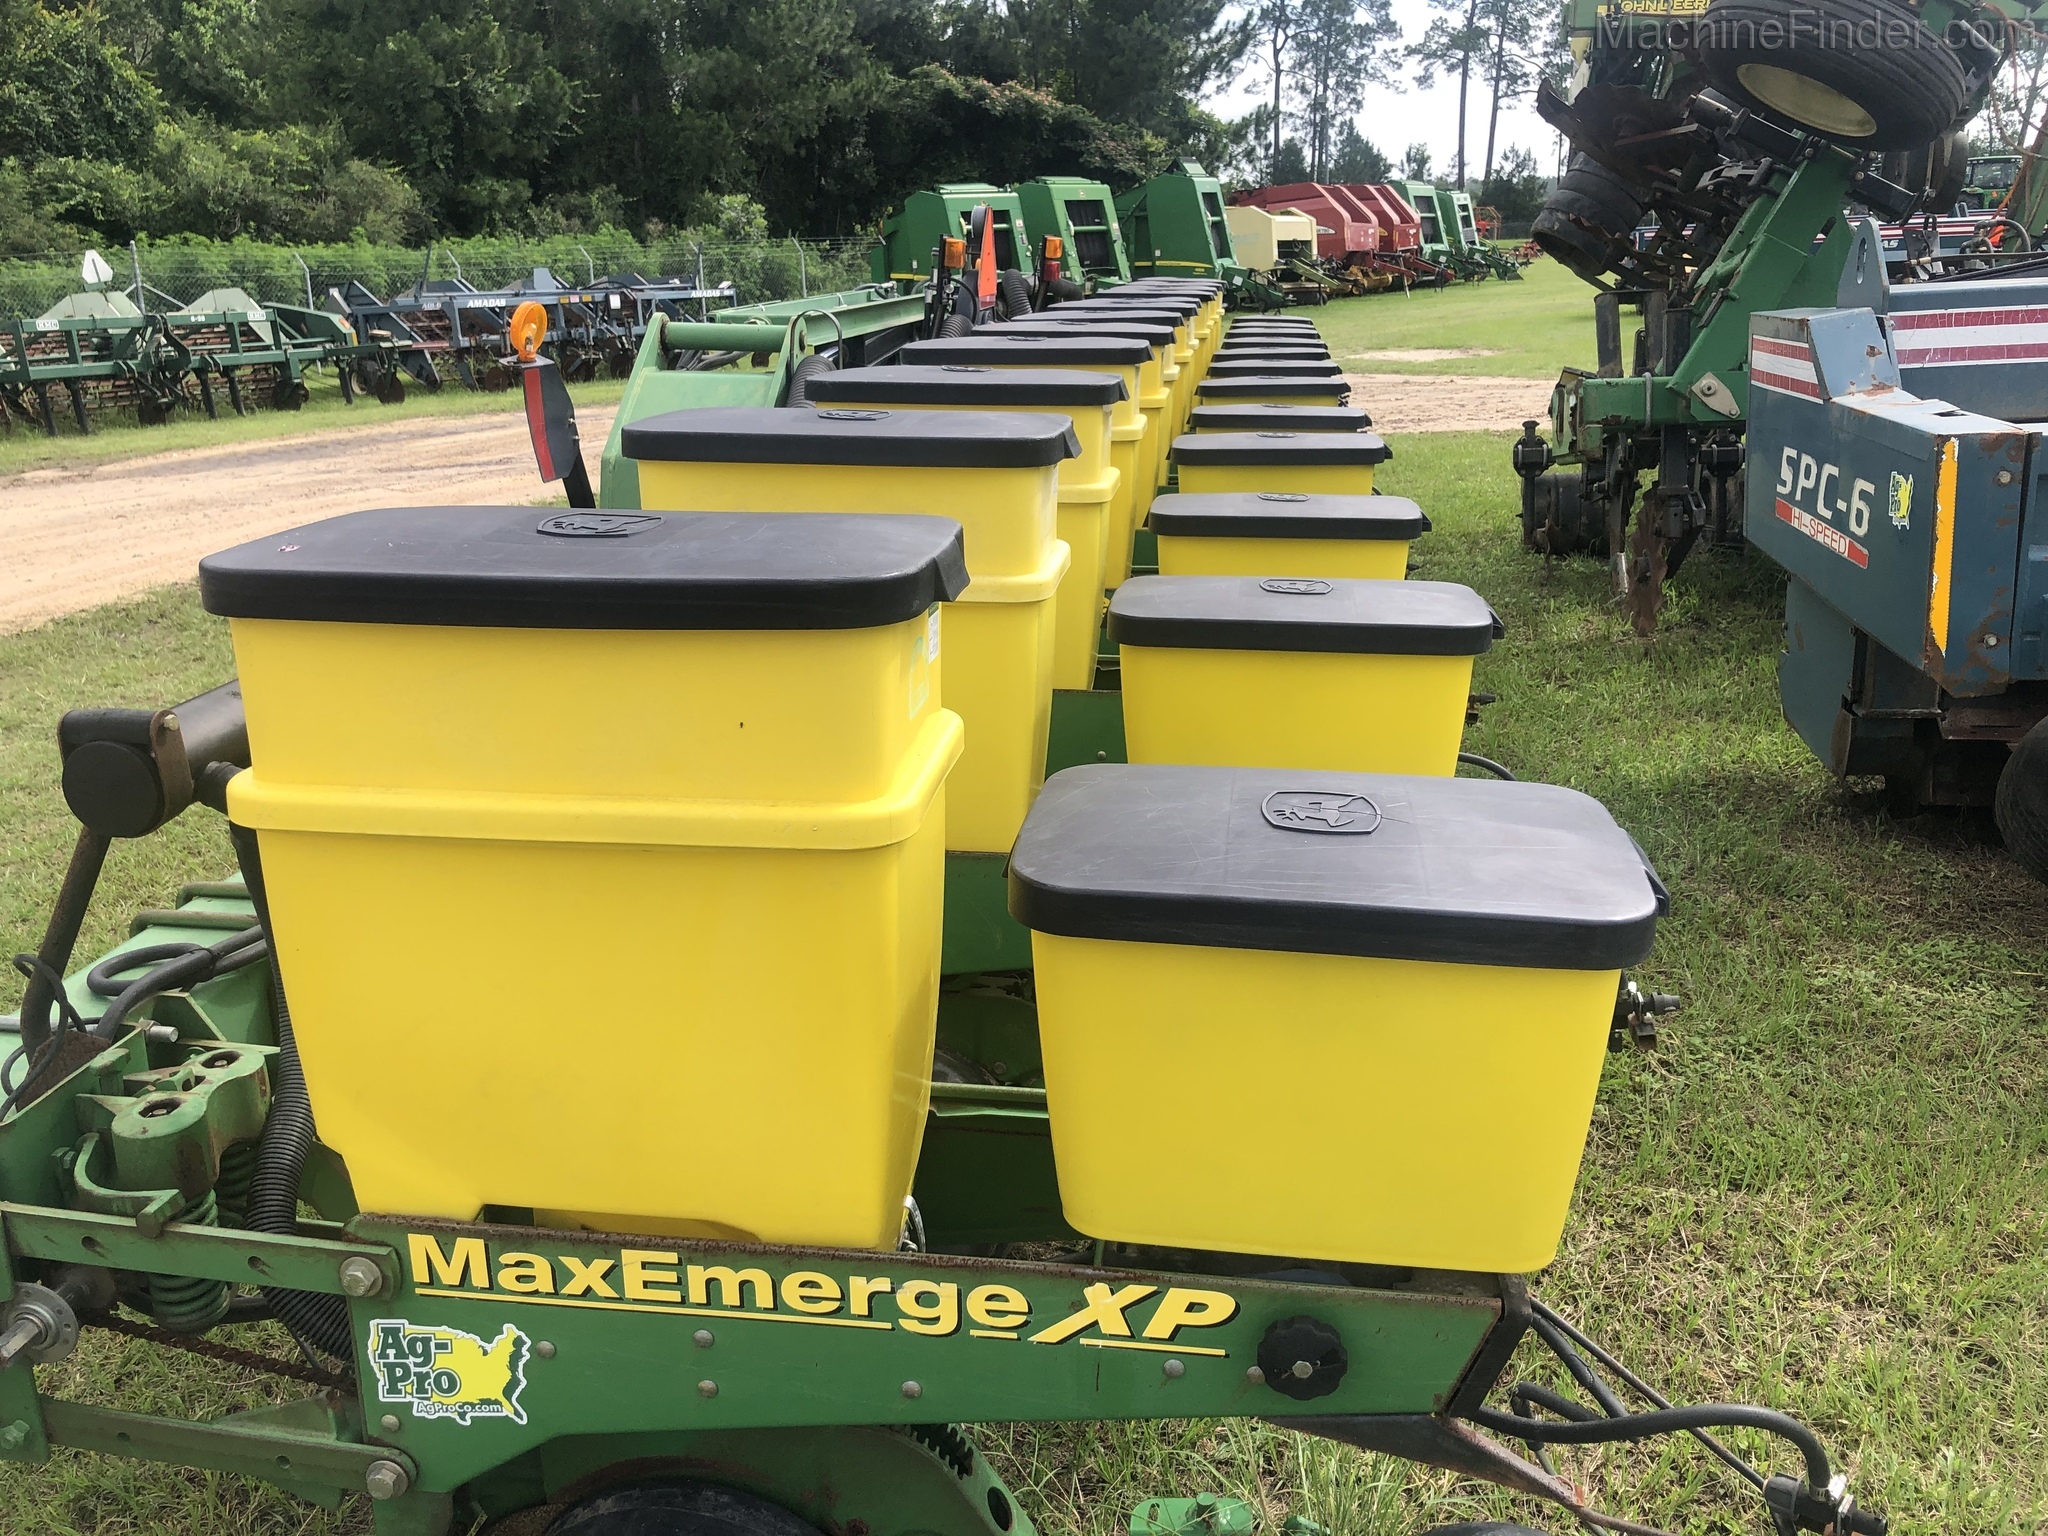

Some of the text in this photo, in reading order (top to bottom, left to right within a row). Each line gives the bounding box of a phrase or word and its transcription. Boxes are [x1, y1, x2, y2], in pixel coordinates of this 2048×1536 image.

[467, 299, 506, 308] AMADAS
[691, 290, 720, 298] AMADAS
[1776, 446, 1875, 537] SPC-6
[1792, 511, 1847, 555] HI-SPEED
[407, 1233, 1237, 1344] MaxEmerge XP
[376, 1324, 452, 1368] Ag-
[381, 1361, 461, 1397] Pro
[416, 1402, 503, 1415] AgProCo.com
